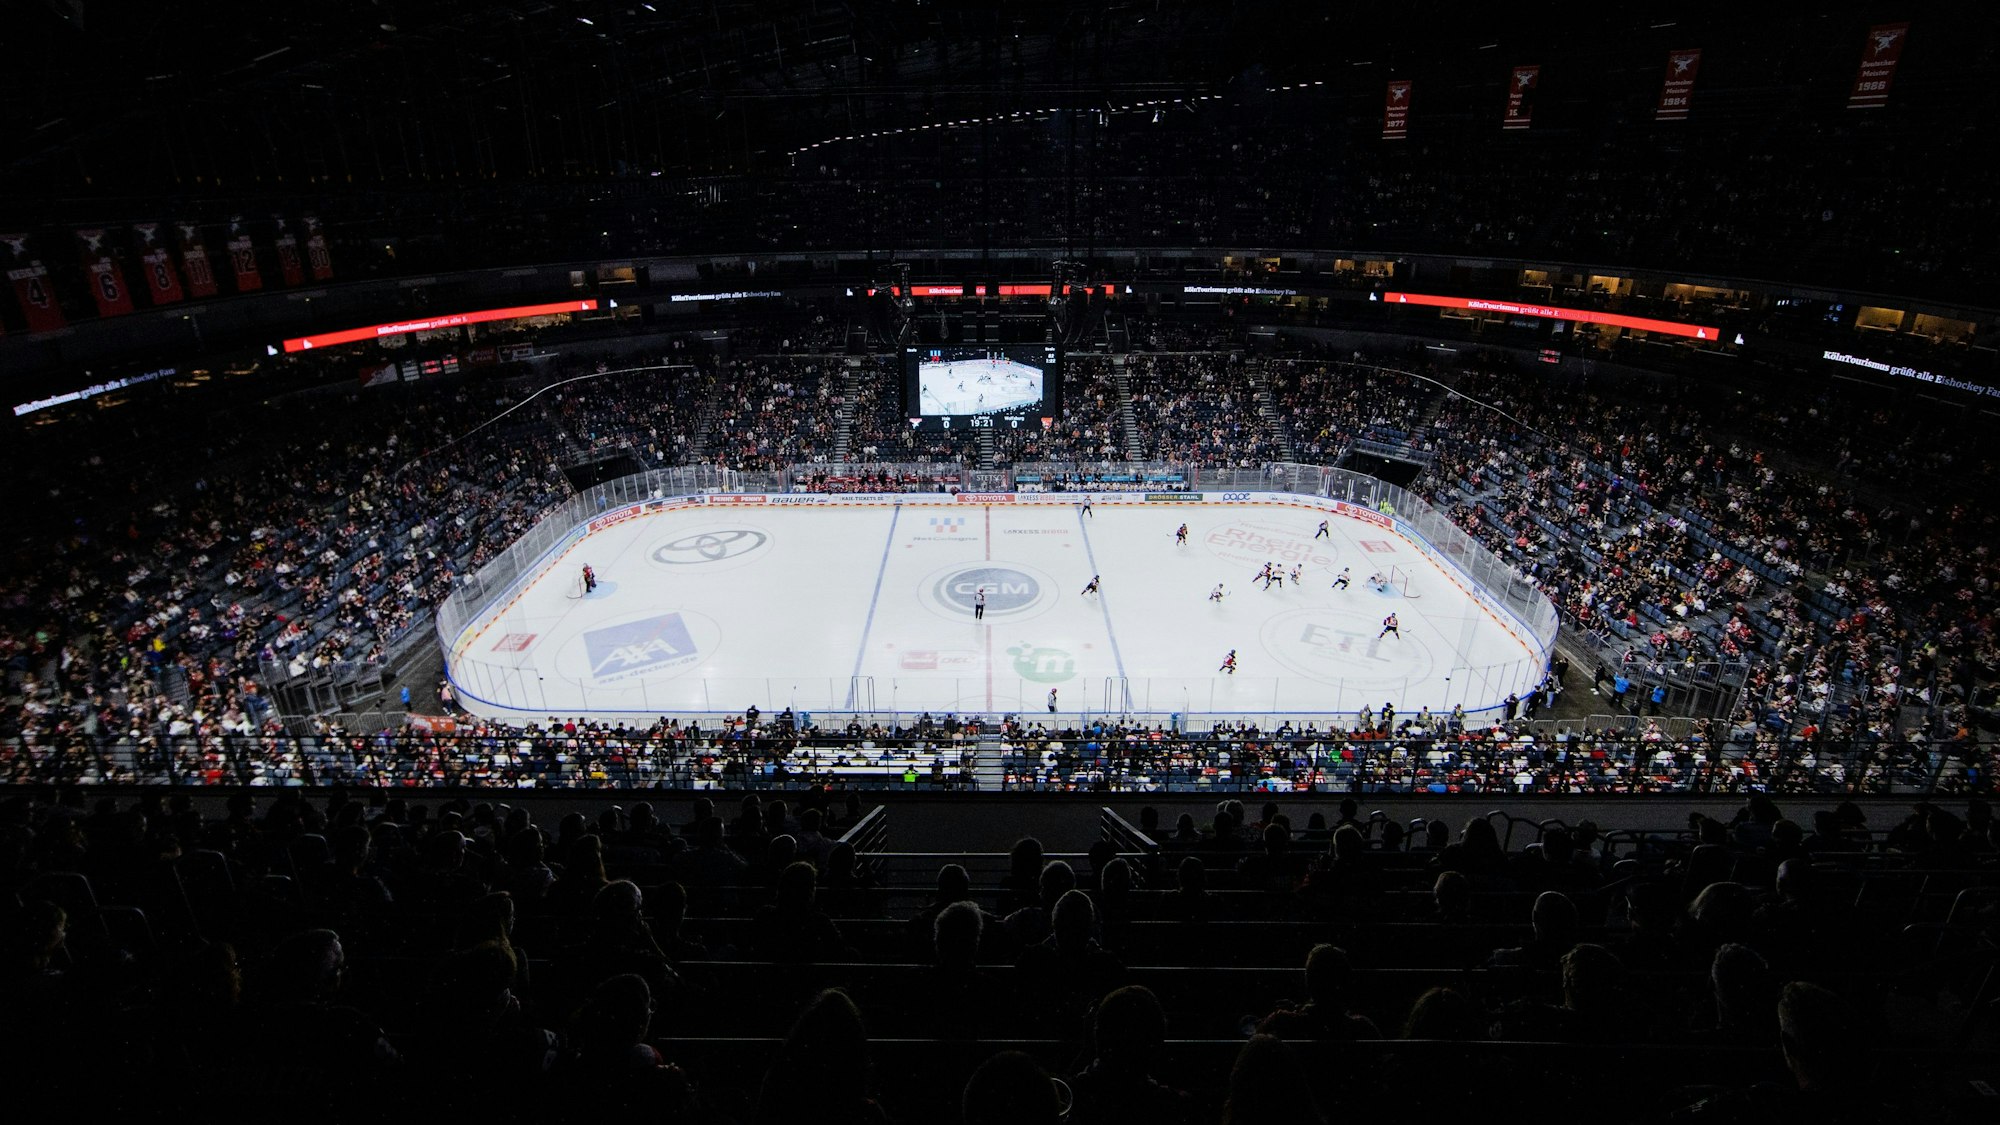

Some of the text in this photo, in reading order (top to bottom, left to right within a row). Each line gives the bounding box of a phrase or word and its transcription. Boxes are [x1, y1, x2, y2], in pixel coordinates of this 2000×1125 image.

[1861, 60, 1896, 68] Deutscher
[1858, 81, 1887, 91] 1986
[1663, 97, 1687, 106] 1984
[1387, 119, 1405, 128] 1977
[230, 249, 257, 274] 12
[154, 264, 170, 290] 8
[29, 277, 49, 308] 4
[98, 272, 119, 301] 6
[1184, 286, 1227, 294] KölnTourismus
[1467, 301, 1520, 312] KölnTourismus
[1519, 307, 1540, 315] grüßt
[1822, 351, 1890, 373] KölnTourismus
[1889, 366, 1916, 379] grüßt
[1916, 371, 1935, 383] alle
[1934, 375, 1986, 396] Eishockey
[943, 421, 949, 429] 0
[970, 419, 994, 427] 19:21
[1012, 421, 1018, 429] 0
[978, 494, 1007, 502] TOYOTA
[607, 509, 634, 524] TOYOTA
[1357, 509, 1386, 525] TOYOTA
[1225, 527, 1314, 553] Rhein
[1206, 533, 1331, 565] Energie
[954, 582, 1030, 595] CGM
[1299, 622, 1393, 664] ETL
[592, 638, 679, 674] AXA
[598, 655, 699, 686] axa-decker.de
